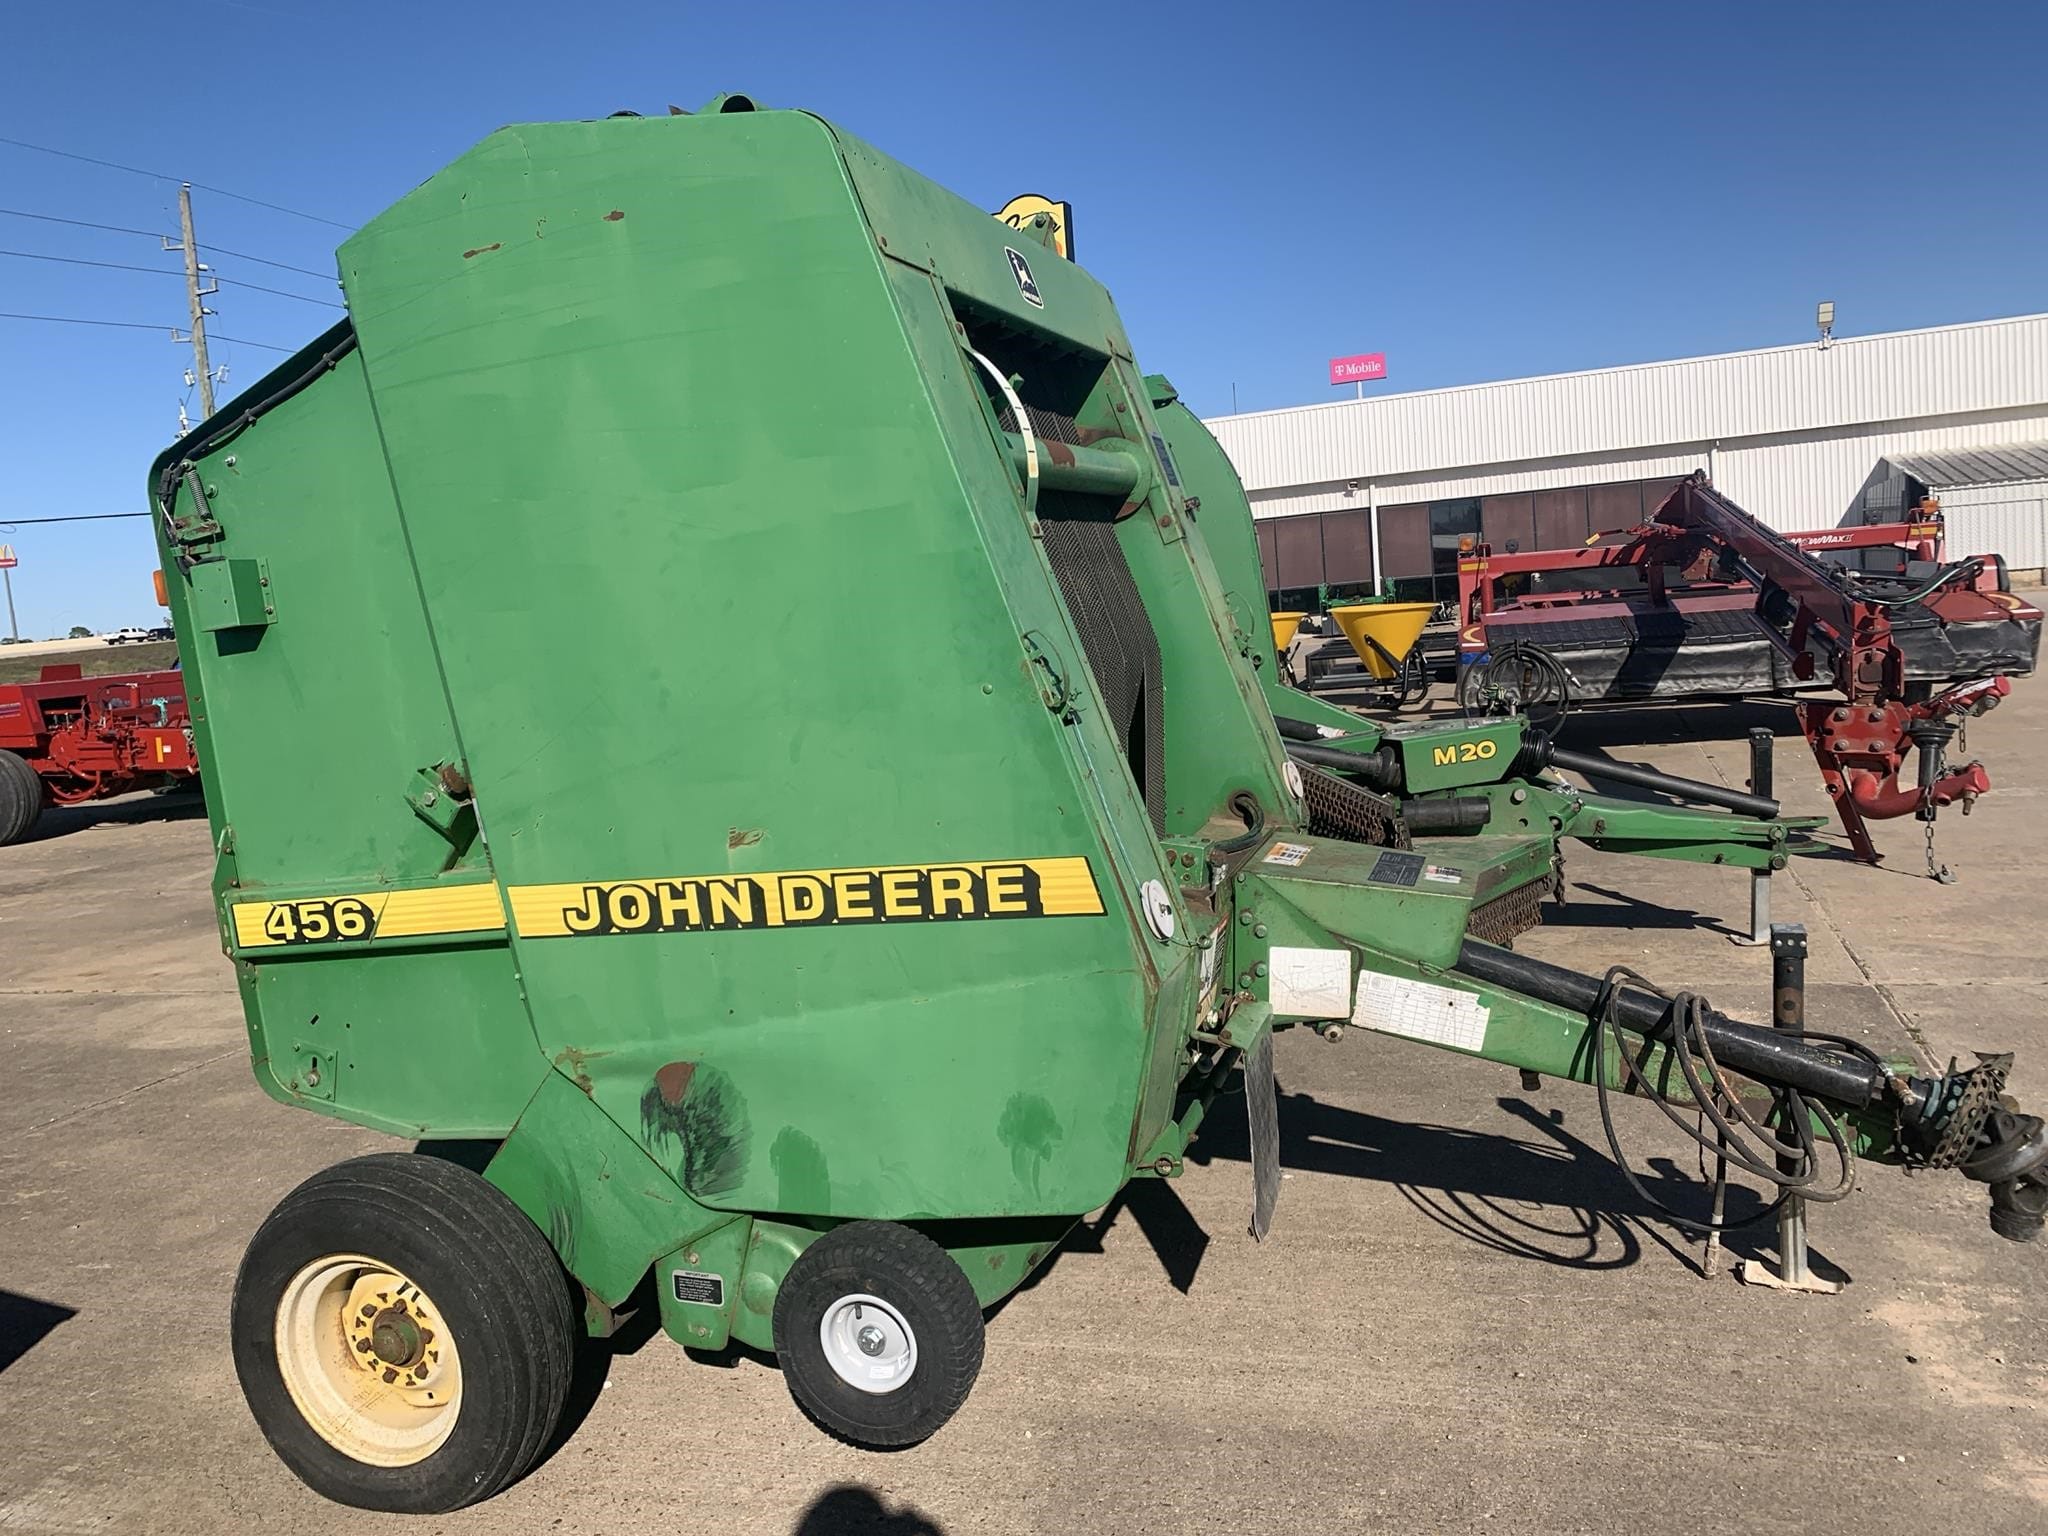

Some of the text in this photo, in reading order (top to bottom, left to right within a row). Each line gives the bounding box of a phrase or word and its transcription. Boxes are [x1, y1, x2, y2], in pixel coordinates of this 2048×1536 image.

[1346, 361, 1381, 375] Mobile
[265, 899, 369, 942] 456
[563, 865, 1030, 934] JOHN DEERE
